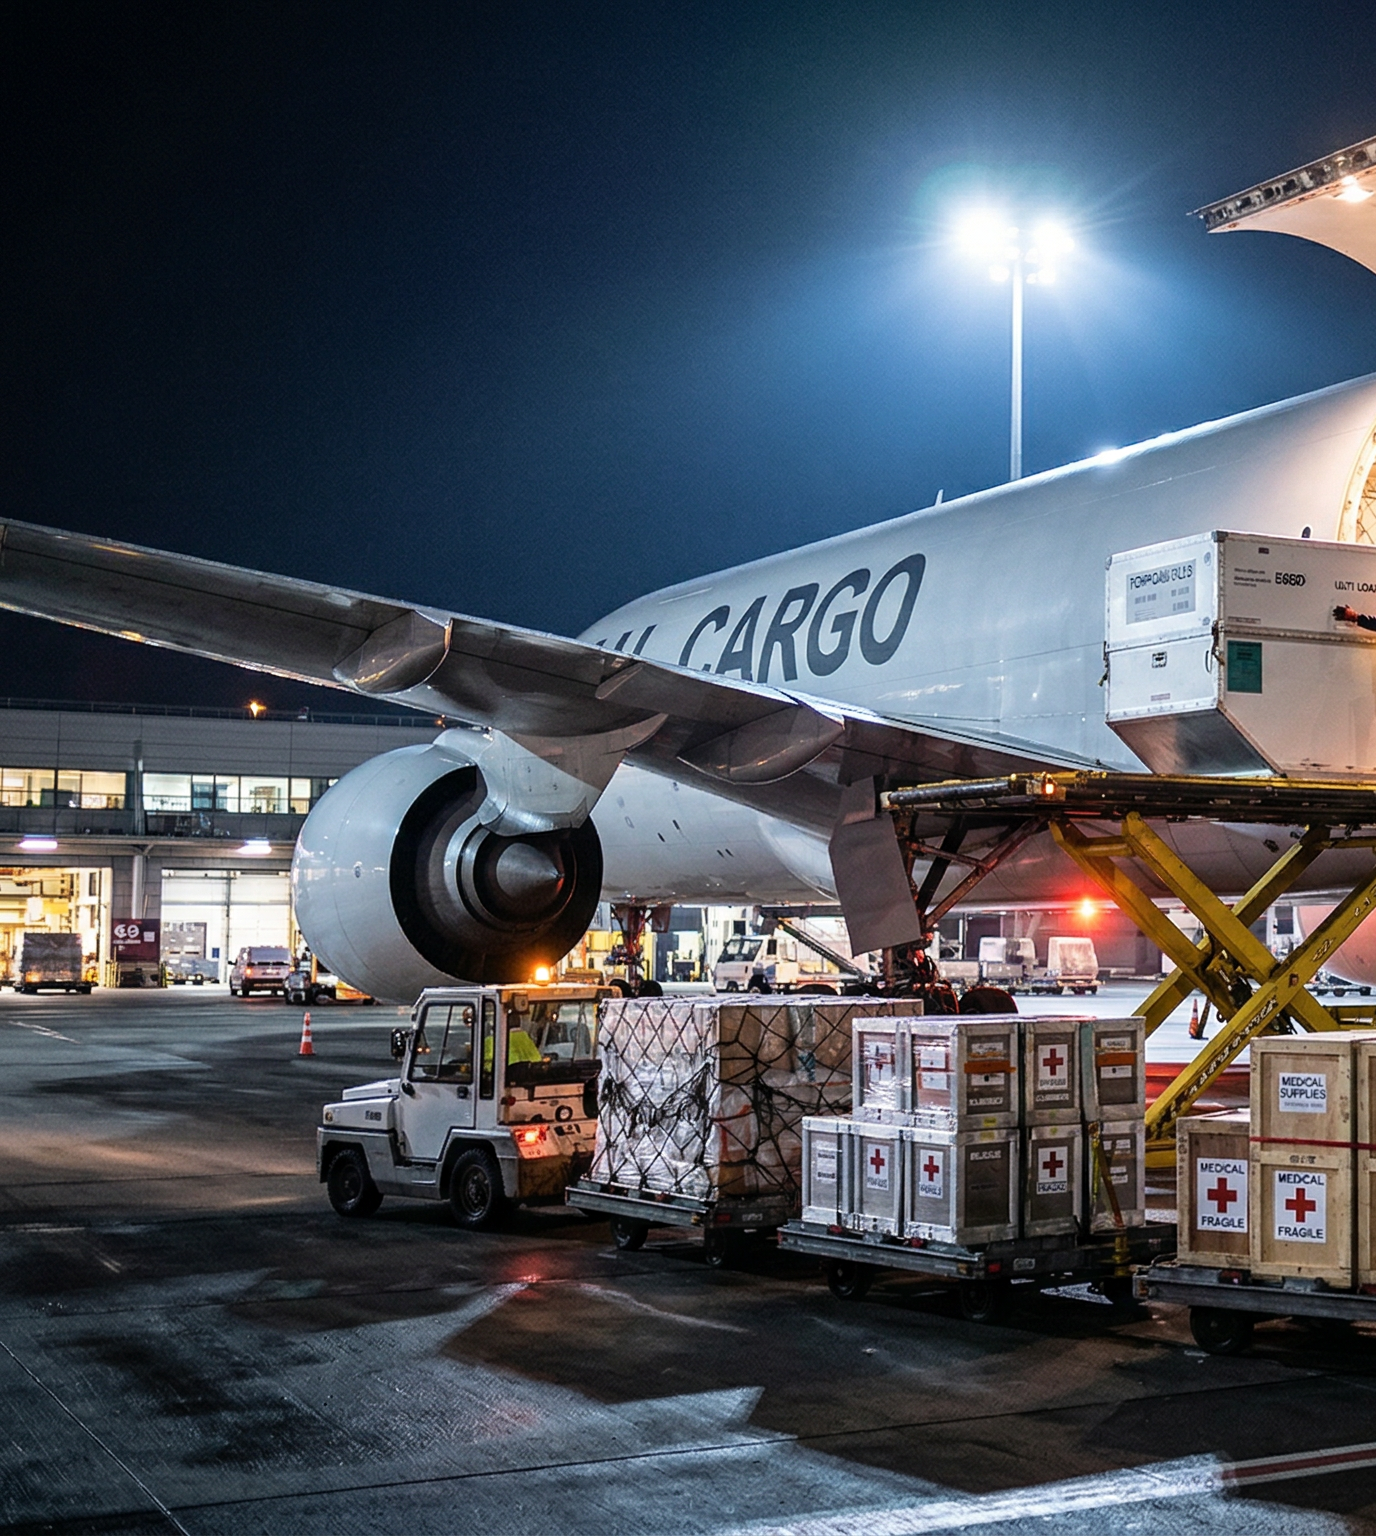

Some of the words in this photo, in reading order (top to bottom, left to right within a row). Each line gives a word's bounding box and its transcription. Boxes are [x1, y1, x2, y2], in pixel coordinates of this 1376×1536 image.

[678, 553, 926, 683] CARGO
[1282, 1076, 1324, 1088] MEDICAL
[1200, 1162, 1245, 1175] MEDICAL
[1278, 1173, 1325, 1186] MEDICAL
[1201, 1216, 1245, 1229] FRAGILE
[1278, 1226, 1324, 1239] FRAGILE
